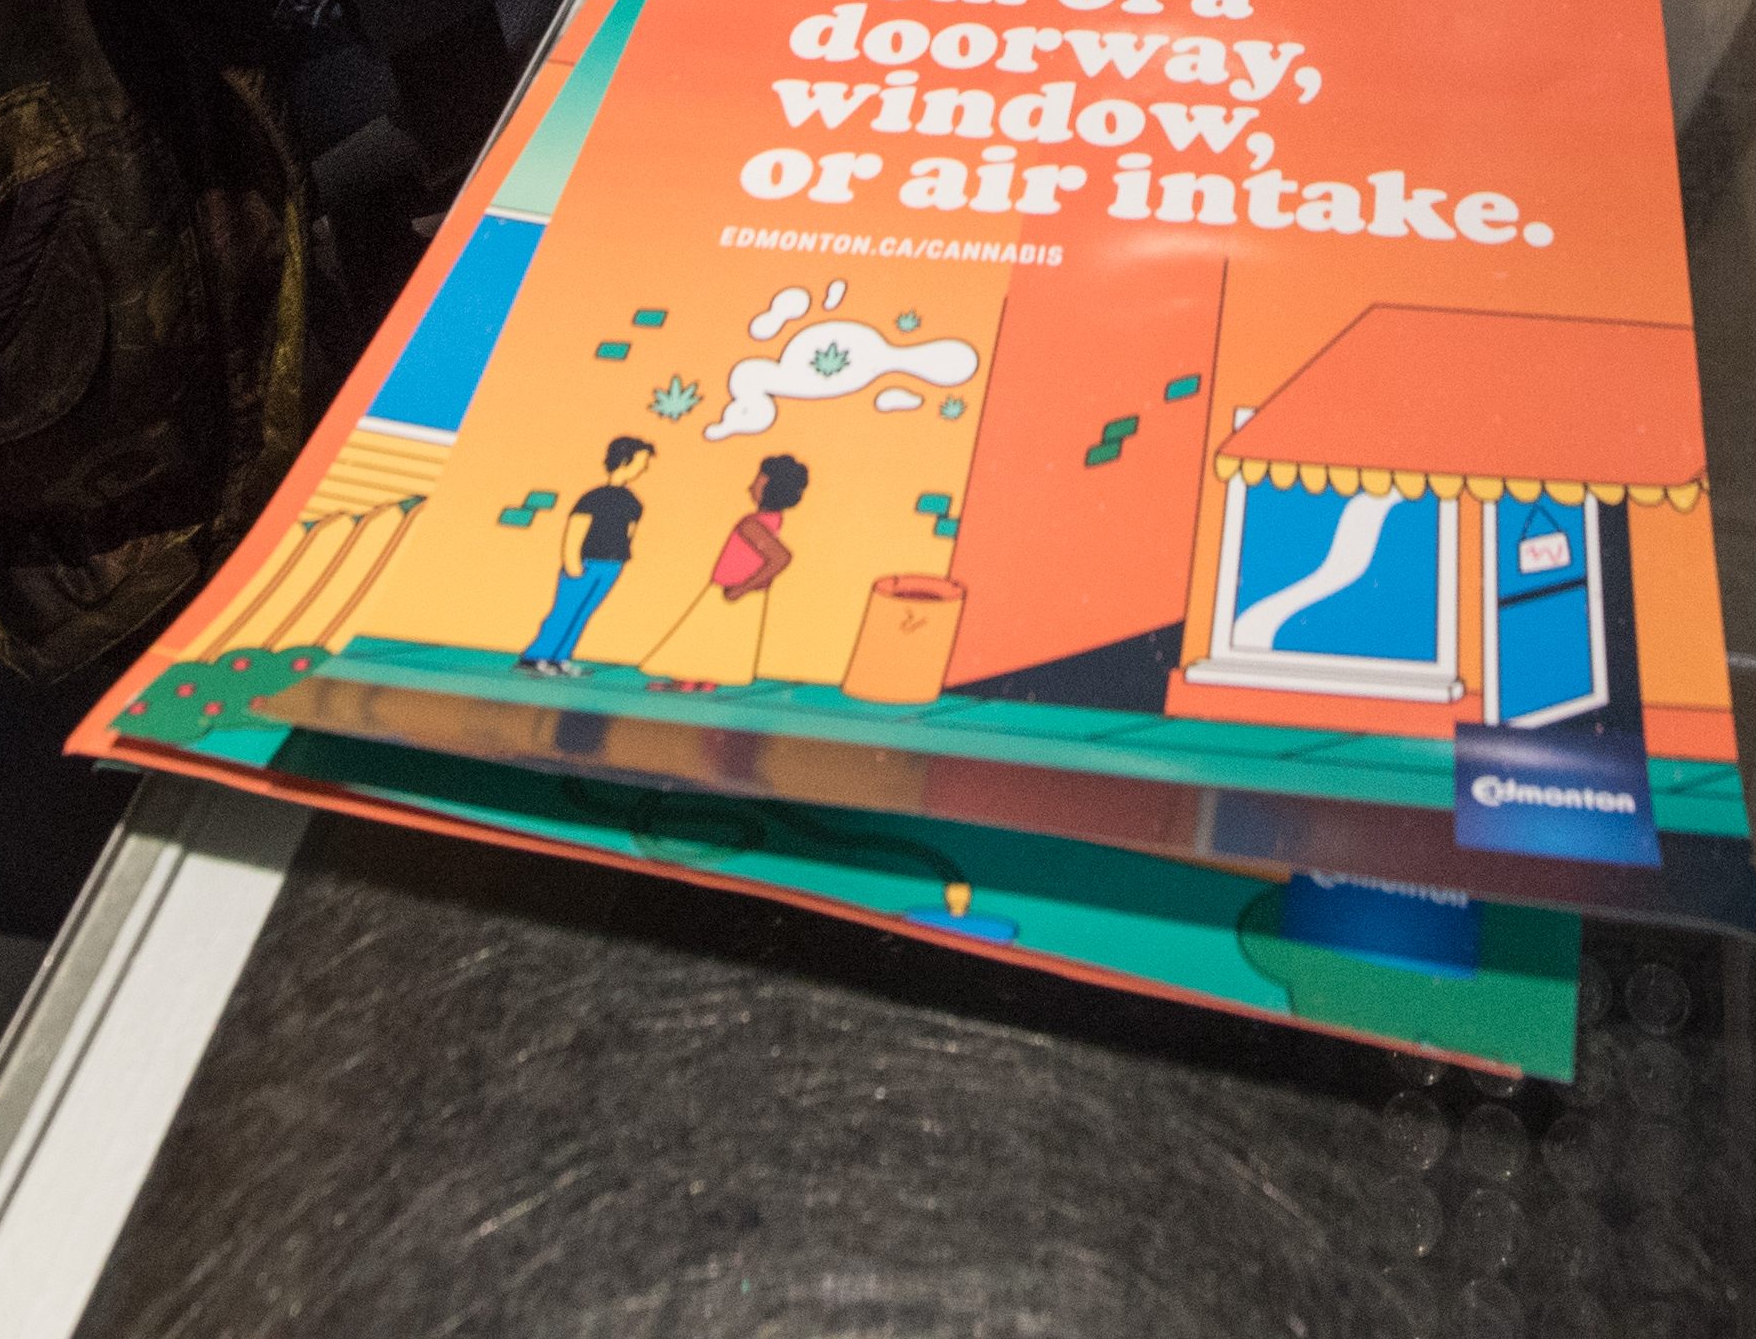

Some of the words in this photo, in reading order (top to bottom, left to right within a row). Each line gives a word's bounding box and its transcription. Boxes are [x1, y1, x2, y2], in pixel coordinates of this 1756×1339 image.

[789, 4, 1322, 103] doorway,
[773, 70, 1274, 170] window,
[720, 226, 1063, 266] EDMONTON.CA/CANNABIS
[740, 149, 883, 205] or
[900, 146, 1086, 215] air
[1109, 154, 1554, 248] intake.
[1471, 774, 1636, 814] Edmonton
